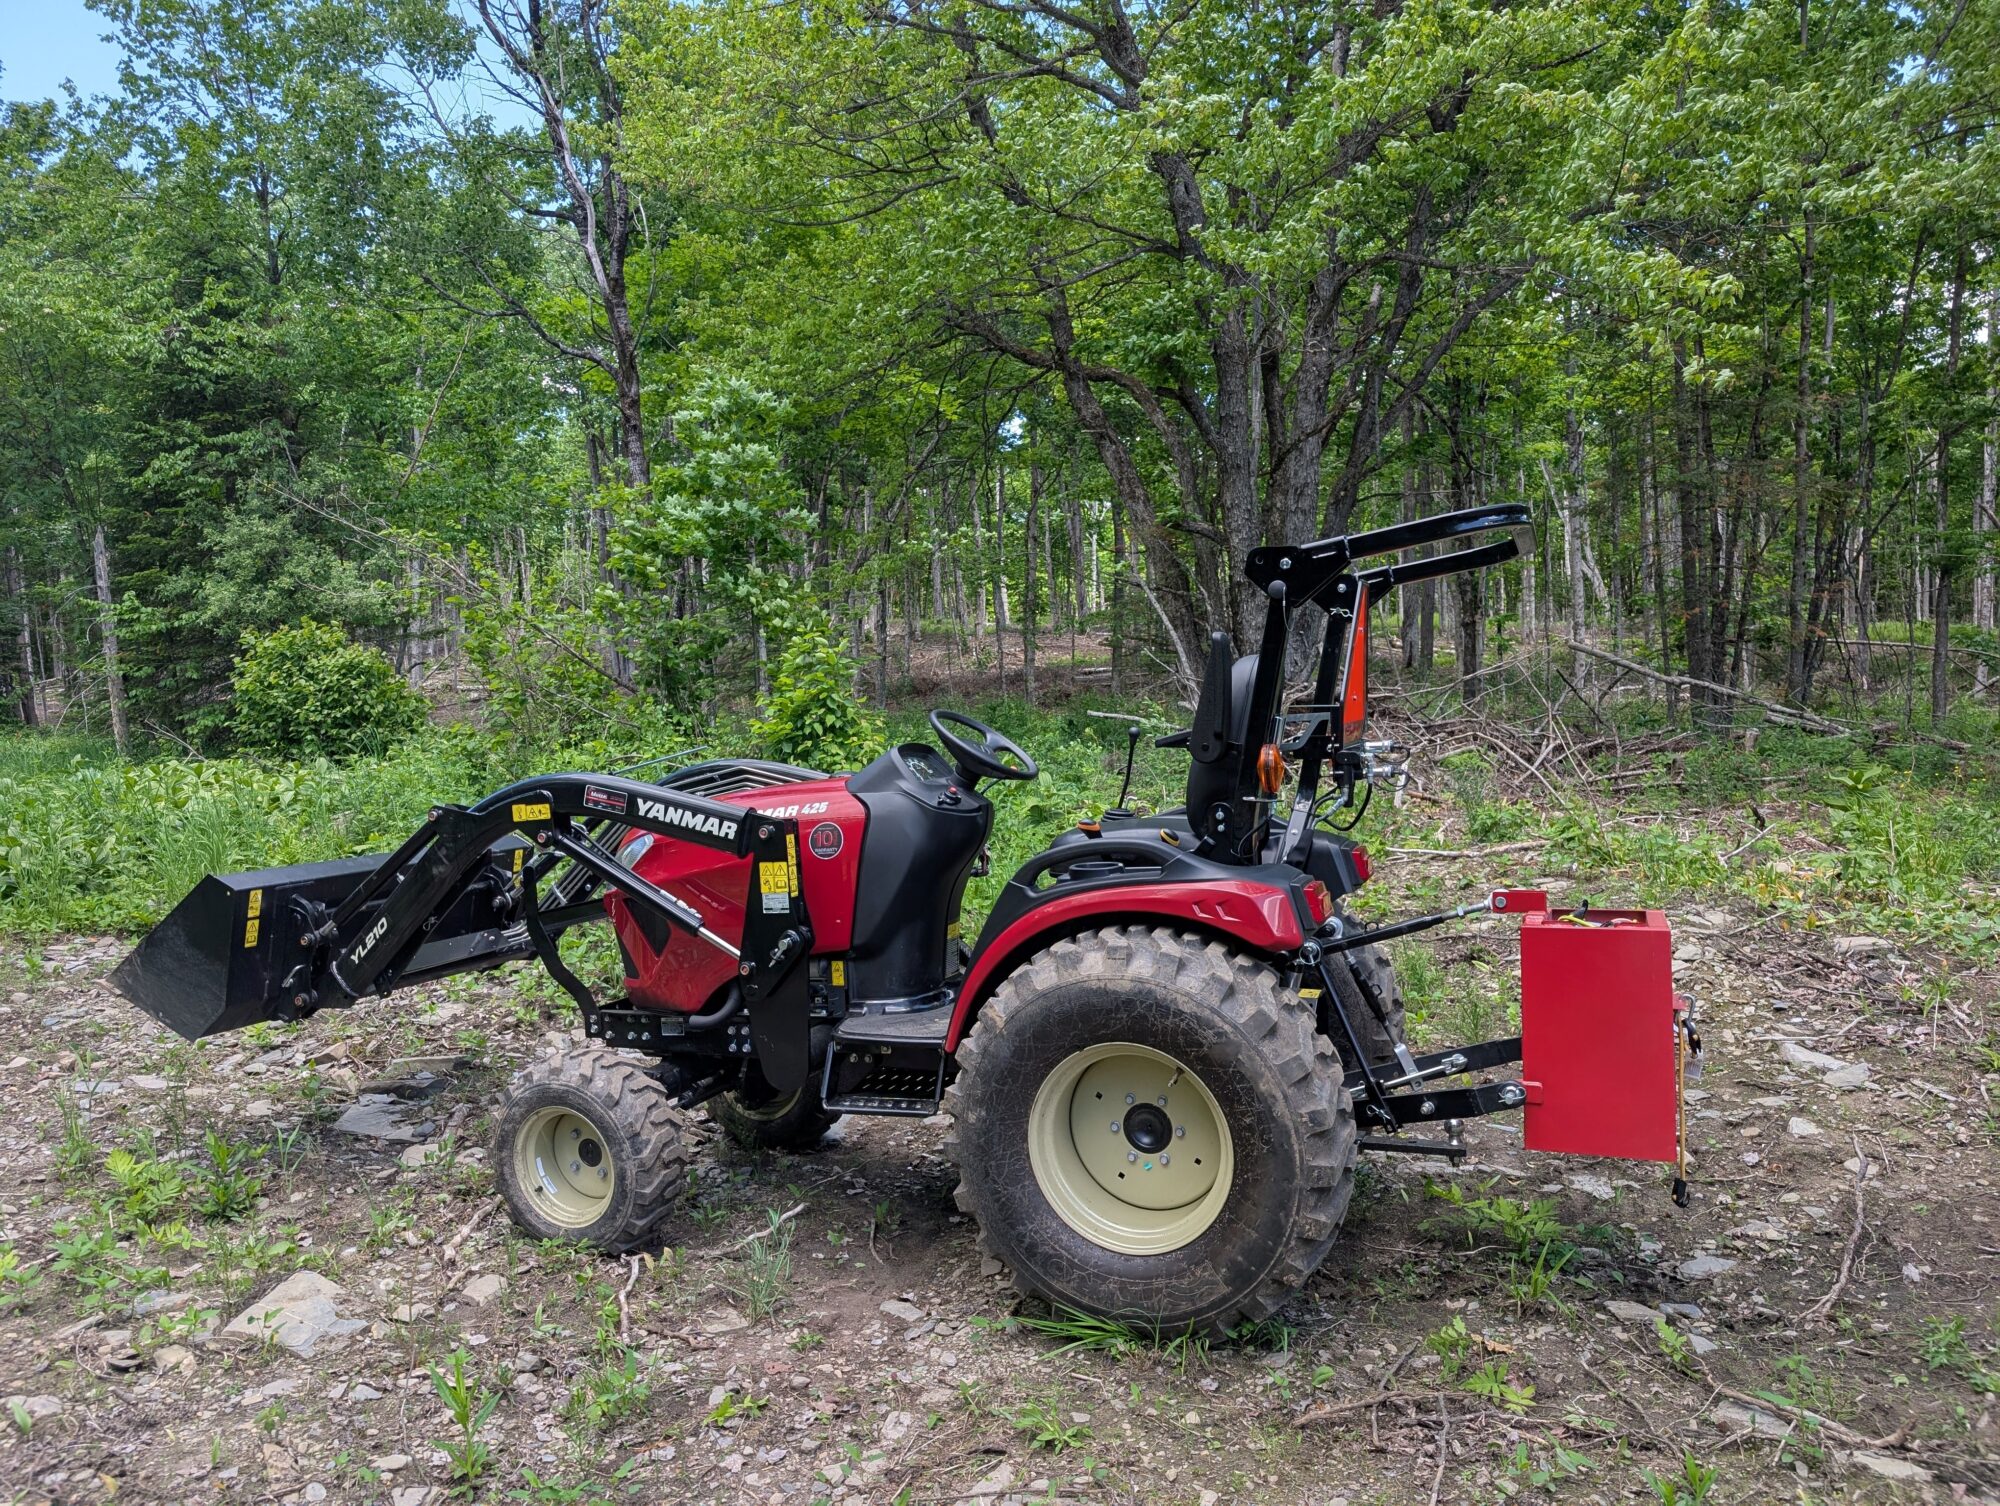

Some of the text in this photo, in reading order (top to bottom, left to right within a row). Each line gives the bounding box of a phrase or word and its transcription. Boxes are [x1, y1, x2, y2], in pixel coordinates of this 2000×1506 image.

[637, 797, 738, 839] YANMAR
[756, 802, 829, 818] MAR 425
[814, 830, 833, 847] 10
[350, 916, 388, 965] YL210
